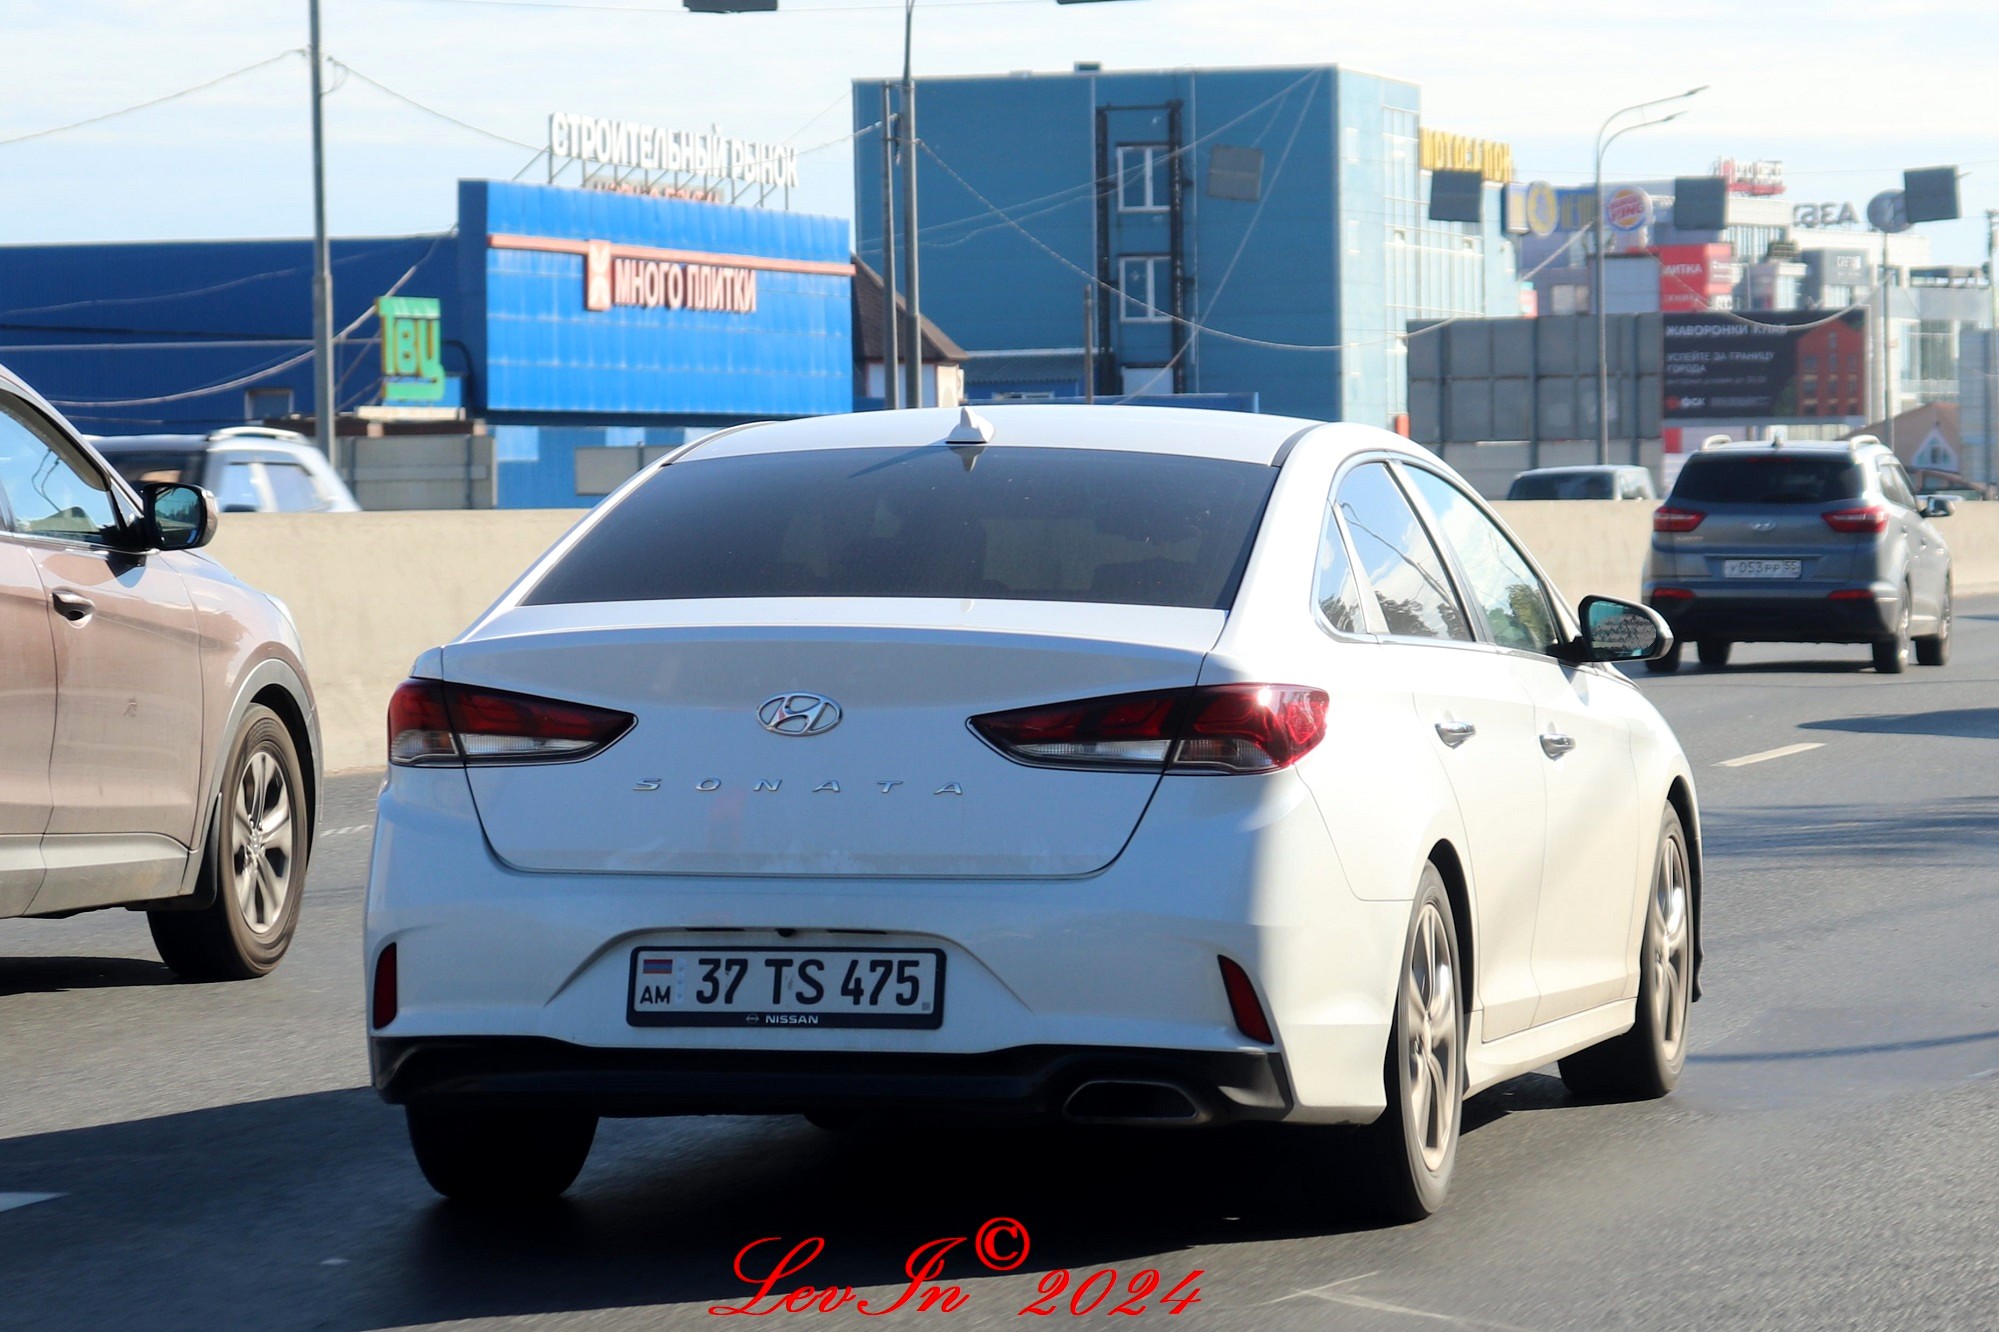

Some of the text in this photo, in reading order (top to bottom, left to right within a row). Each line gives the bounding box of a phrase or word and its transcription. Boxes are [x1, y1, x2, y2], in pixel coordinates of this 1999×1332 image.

[550, 111, 799, 188] СТРОИТЕЛЬНЫЙ РЫНОК
[614, 257, 756, 314] МНОГО ПЛИТКИ
[1666, 324, 1749, 336] ЖАВОРОНКИ
[633, 778, 963, 795] SONATA
[696, 958, 921, 1006] 37 TS 475
[639, 986, 671, 1004] AM
[765, 1014, 819, 1024] NISSAN
